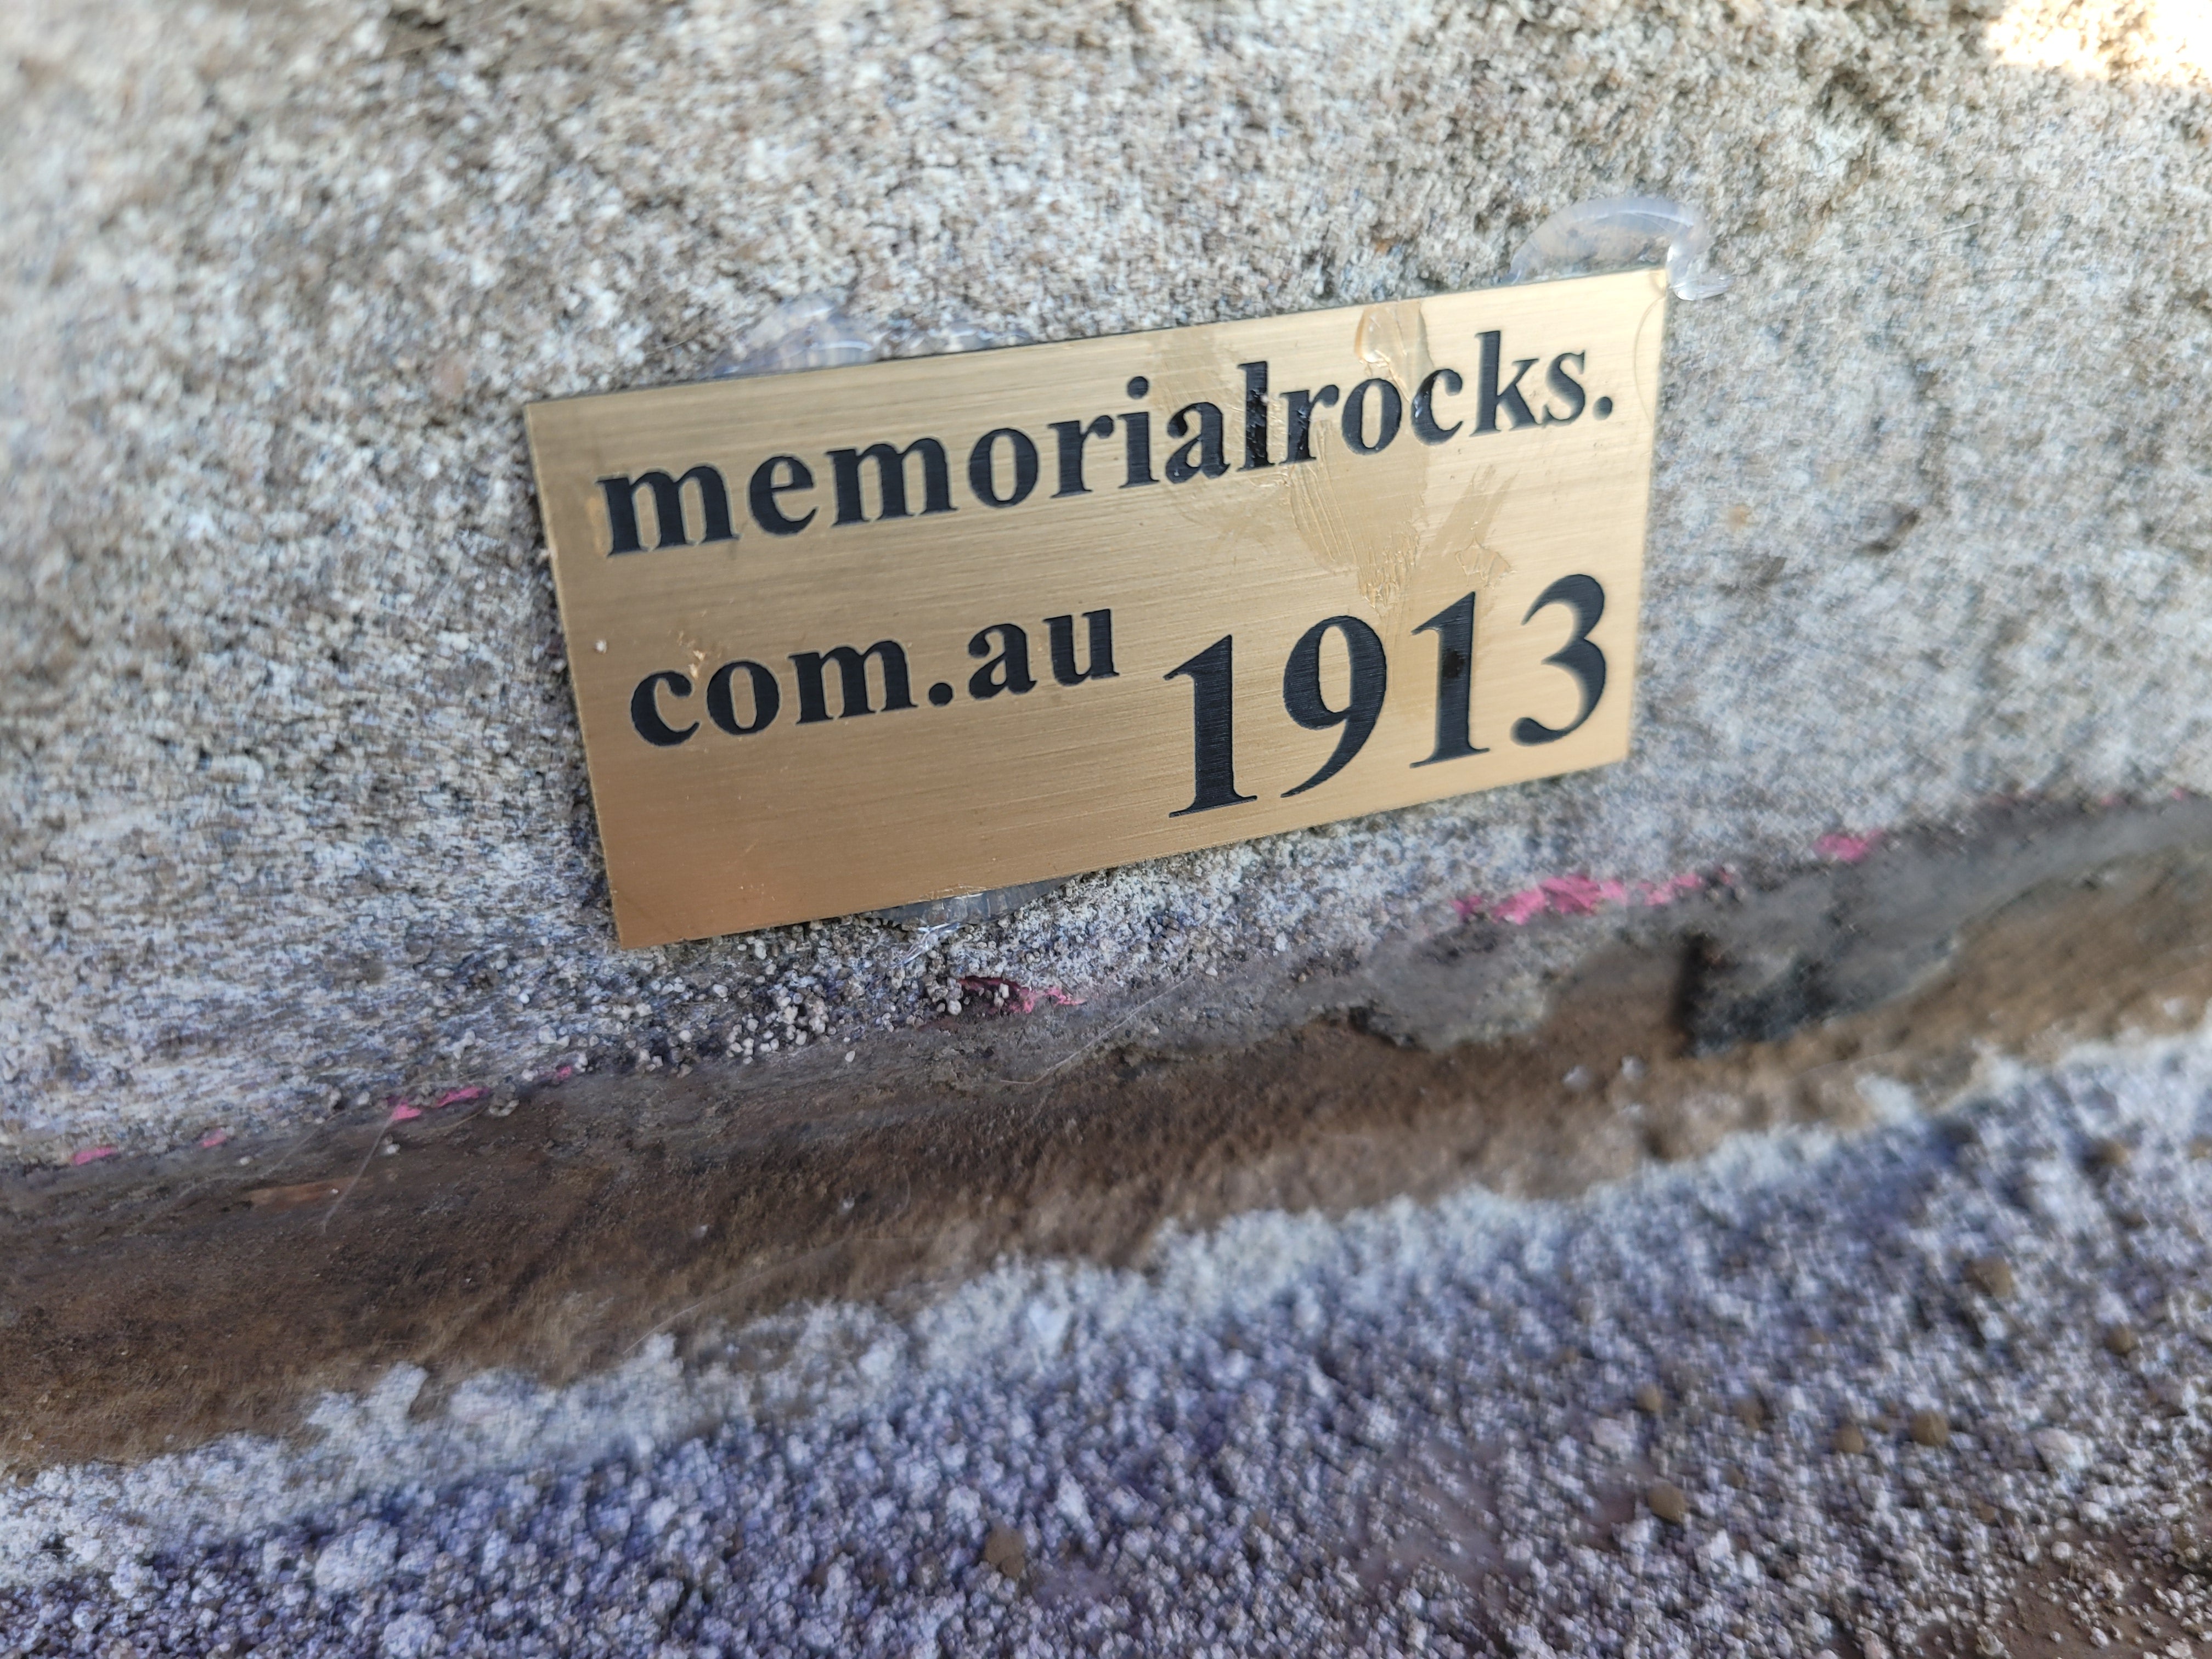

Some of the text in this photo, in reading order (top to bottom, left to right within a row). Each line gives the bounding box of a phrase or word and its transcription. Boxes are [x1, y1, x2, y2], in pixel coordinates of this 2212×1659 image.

[596, 330, 1614, 557] memorialrocks.
[630, 608, 1120, 747] com.au
[1162, 573, 1607, 819] 1913
